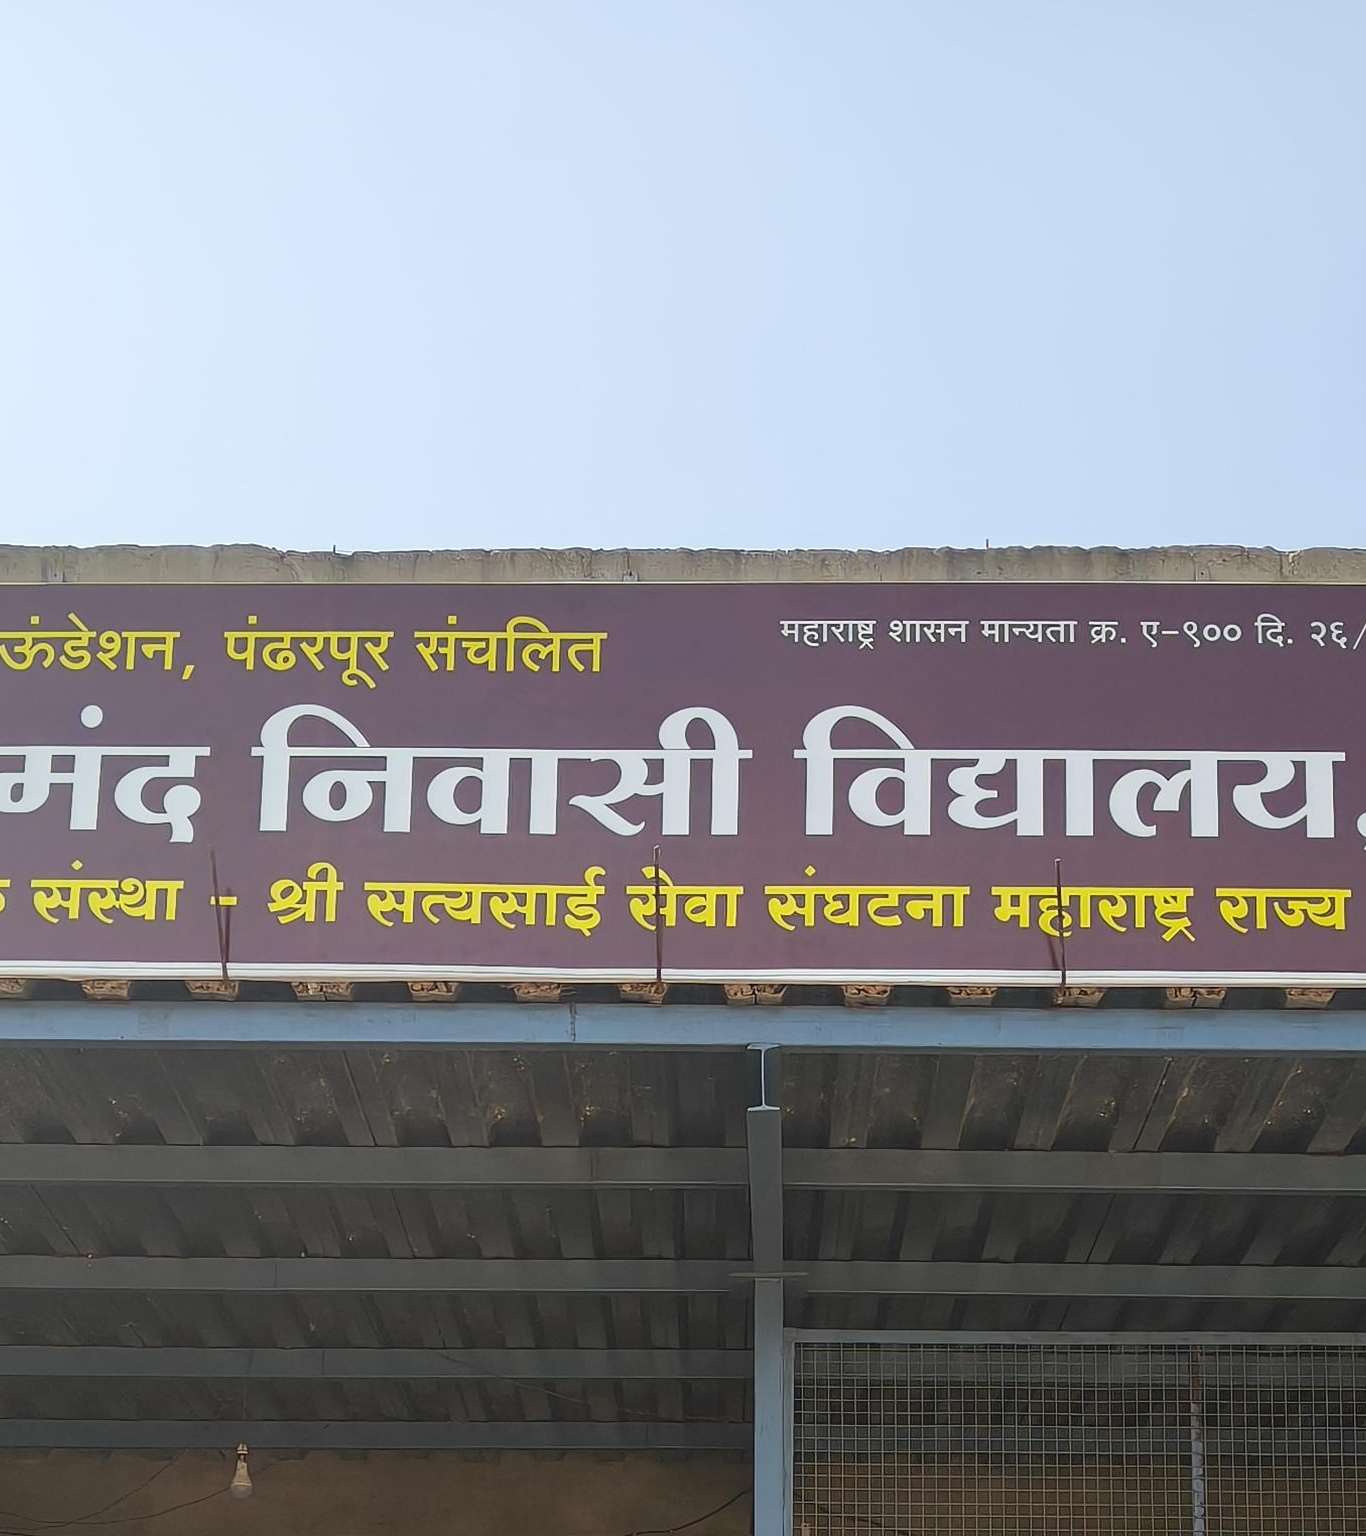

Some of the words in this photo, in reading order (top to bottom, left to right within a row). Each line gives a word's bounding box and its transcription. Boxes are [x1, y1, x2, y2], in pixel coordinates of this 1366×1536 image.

[224, 616, 395, 689] पंढरपूर
[415, 616, 607, 676] संचलित
[779, 618, 877, 649] महाराष्ट्र
[889, 618, 970, 644] शासन
[981, 619, 1078, 645] मान्यता
[1089, 619, 1127, 645] क्र.
[1254, 613, 1293, 645] दि.
[252, 703, 753, 836] निवासी
[31, 860, 185, 925] संस्था
[267, 861, 343, 925] श्री
[365, 864, 607, 937] सत्यसाई
[625, 866, 747, 932] सेवा
[763, 868, 968, 930] संघटना
[993, 884, 1194, 945] महाराष्ट्र
[1214, 886, 1353, 935] राज्य
